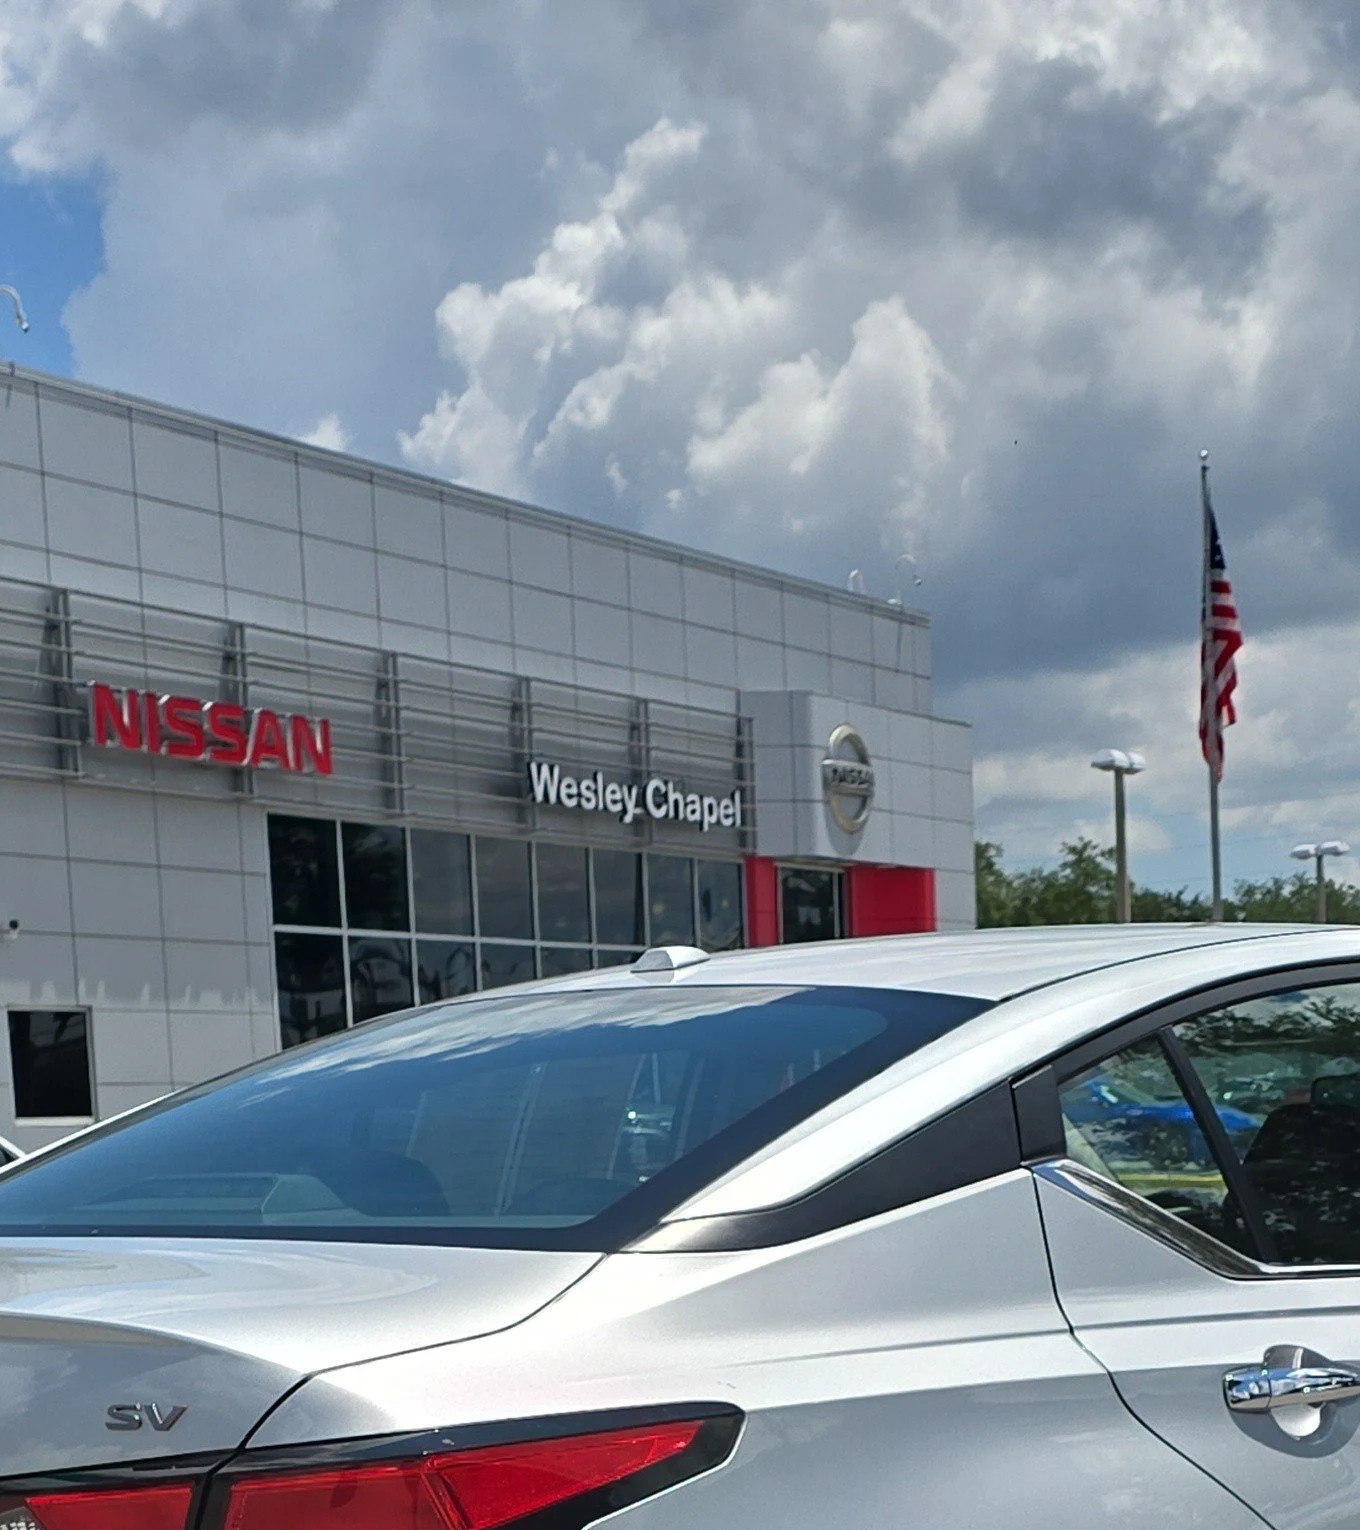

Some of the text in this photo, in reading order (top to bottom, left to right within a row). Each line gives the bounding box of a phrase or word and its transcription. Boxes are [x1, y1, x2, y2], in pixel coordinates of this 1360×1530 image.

[92, 682, 334, 776] NISSAN
[528, 761, 742, 832] Wesley Chapel
[105, 1401, 188, 1431] SV
